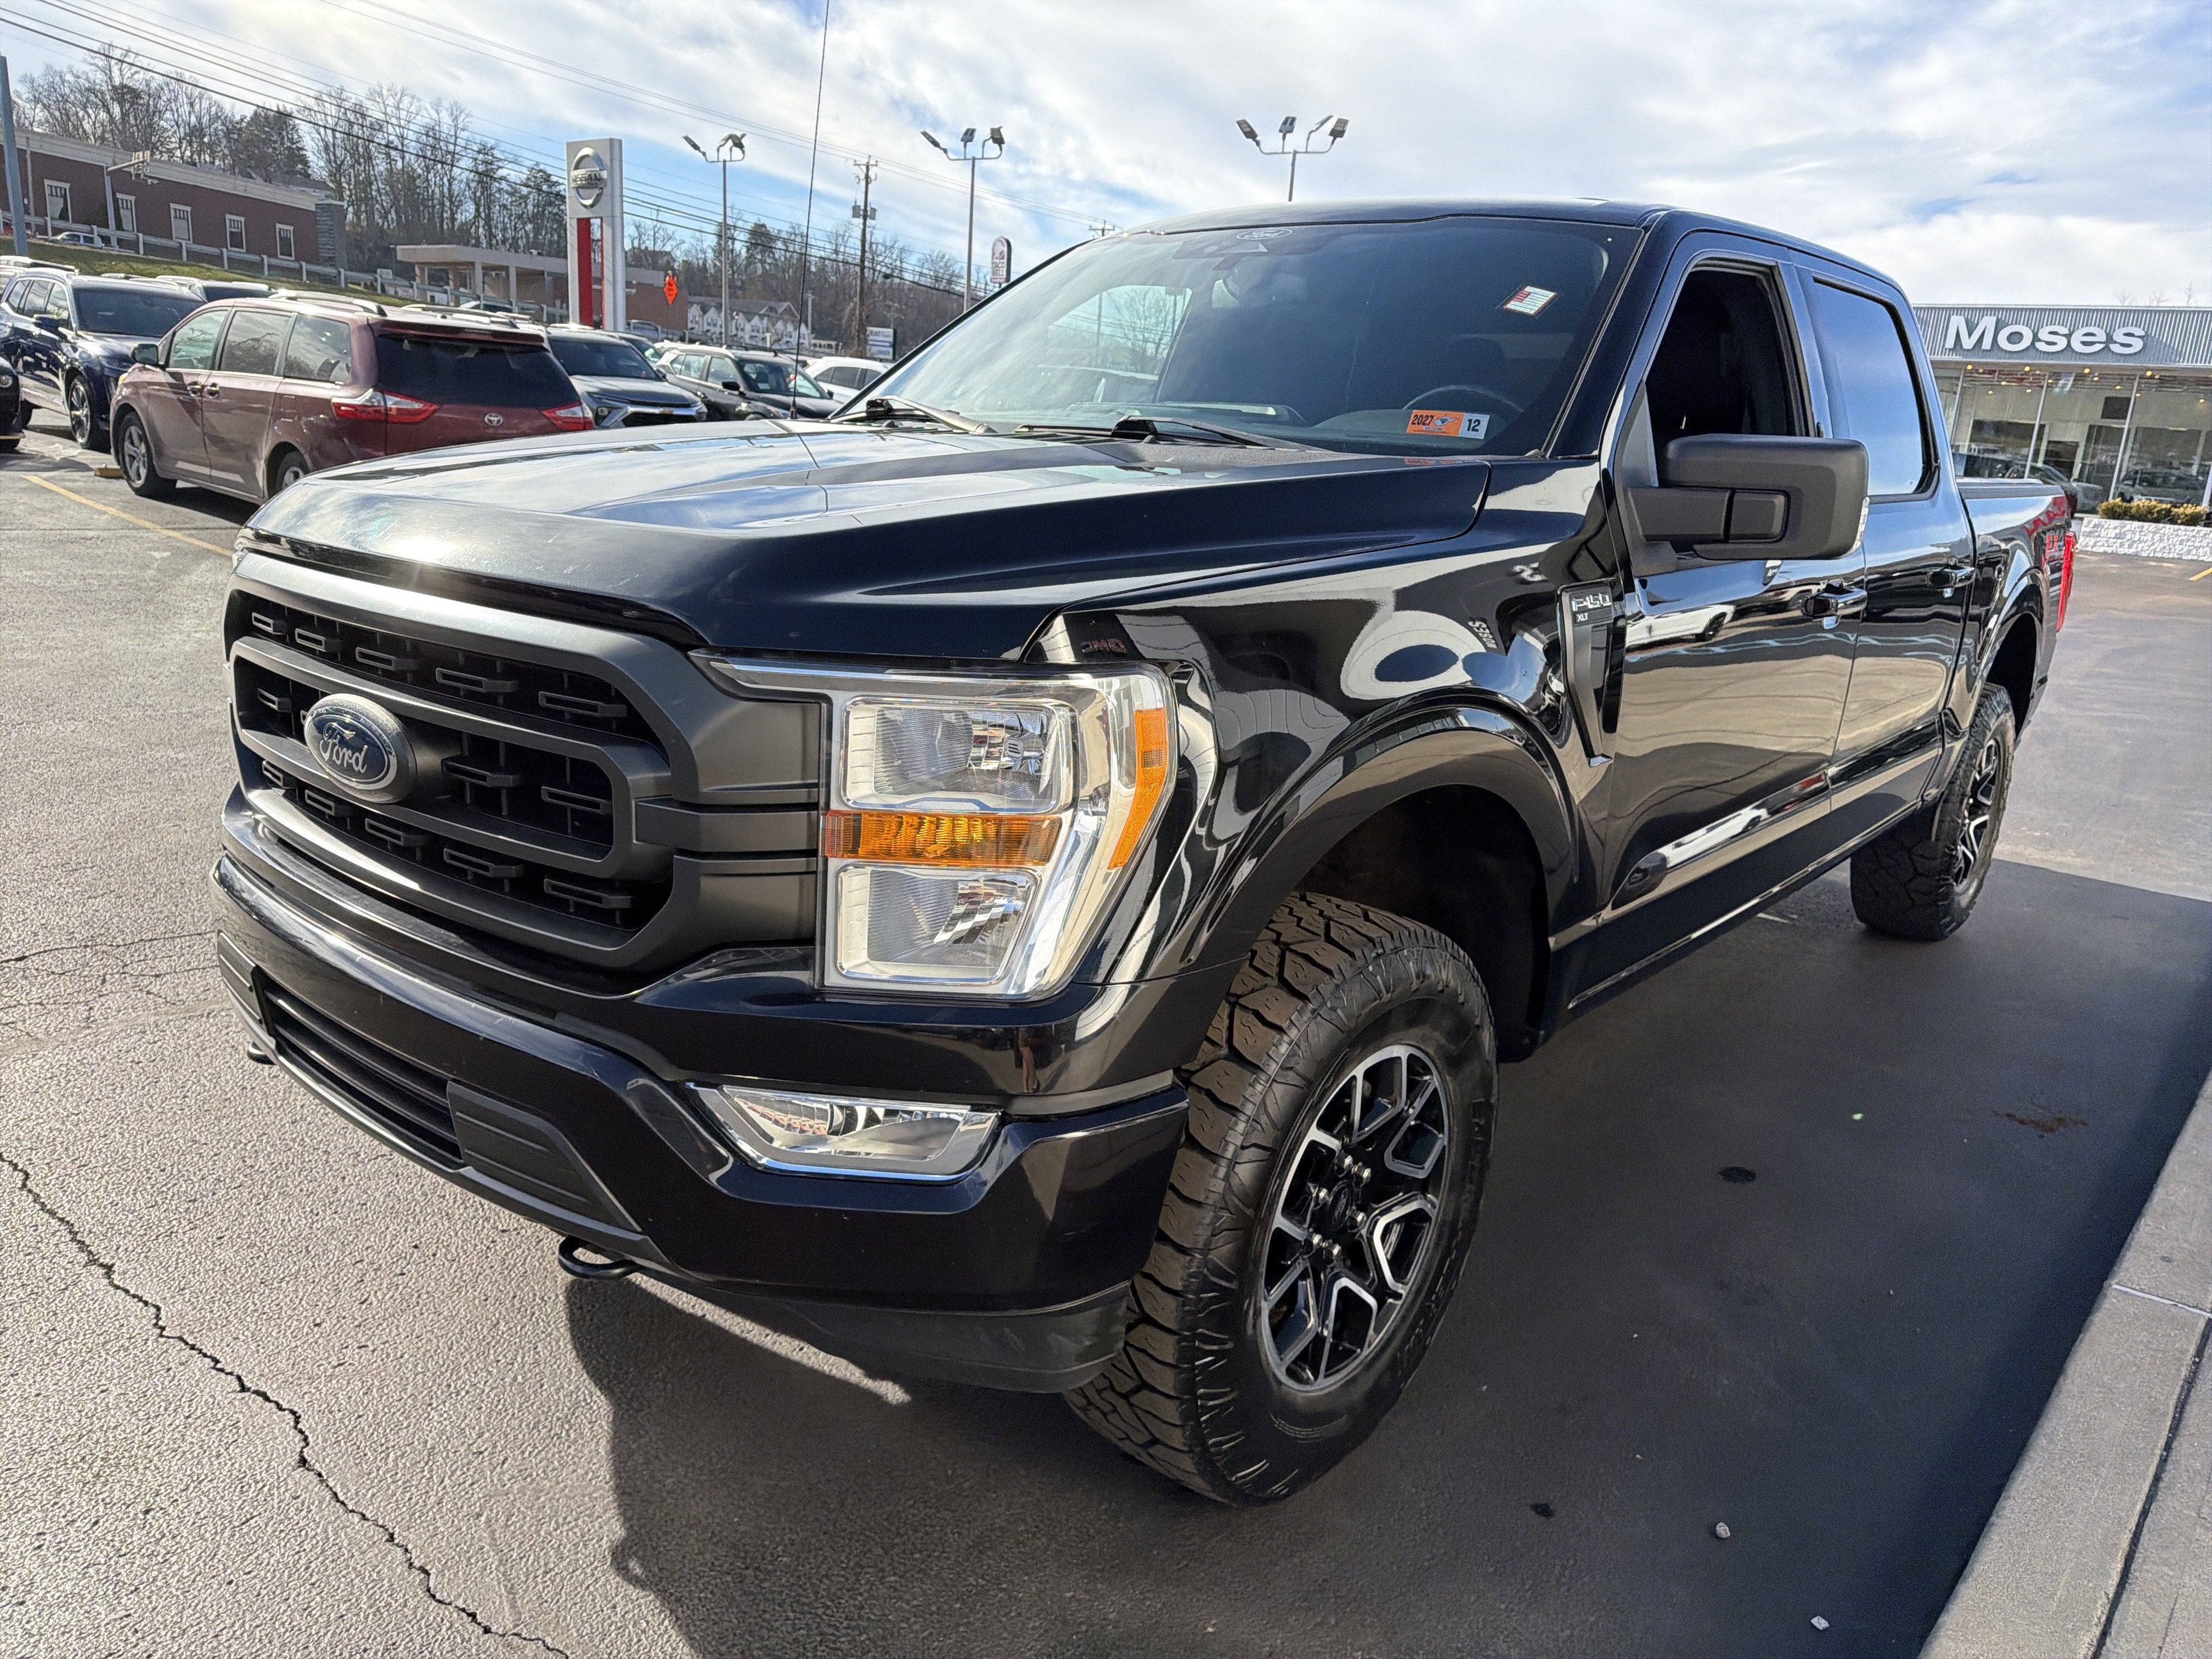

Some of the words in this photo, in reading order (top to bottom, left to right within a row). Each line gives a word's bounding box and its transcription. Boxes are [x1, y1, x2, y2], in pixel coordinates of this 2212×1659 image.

[1945, 315, 2146, 354] Moses
[1411, 414, 1434, 426] 2027
[1467, 419, 1481, 432] 12
[1571, 593, 1612, 612] F-150
[1576, 612, 1588, 623] XLT
[319, 722, 368, 774] Ford
